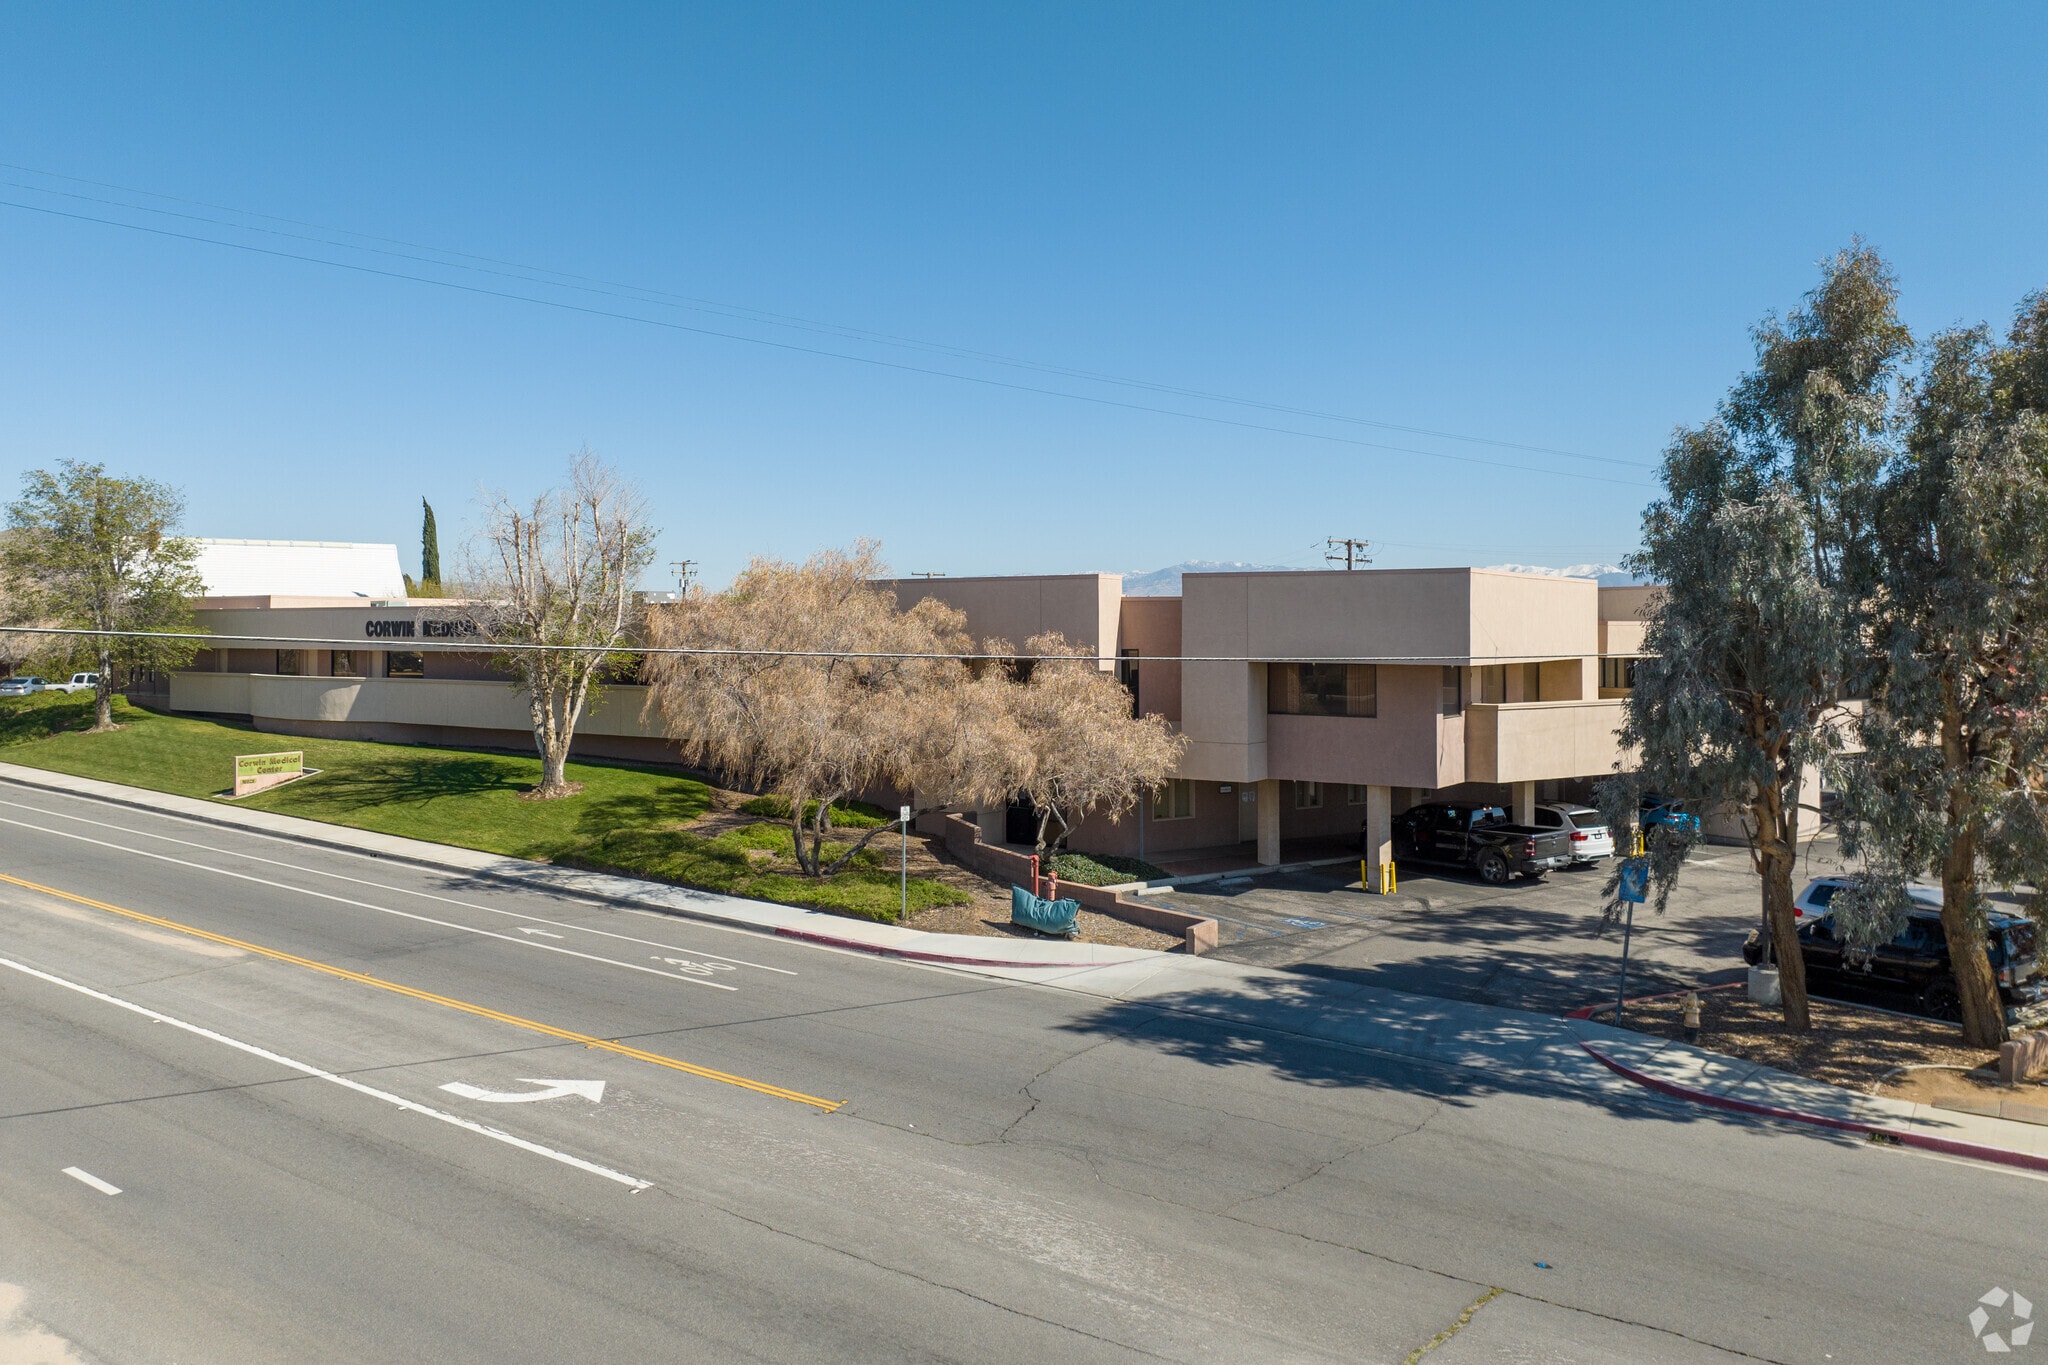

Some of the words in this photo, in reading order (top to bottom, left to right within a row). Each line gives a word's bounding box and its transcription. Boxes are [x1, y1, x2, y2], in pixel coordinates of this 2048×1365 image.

[365, 620, 415, 637] CORWIN
[238, 759, 266, 768] Corwin
[269, 755, 300, 766] Medical
[256, 766, 283, 774] Center
